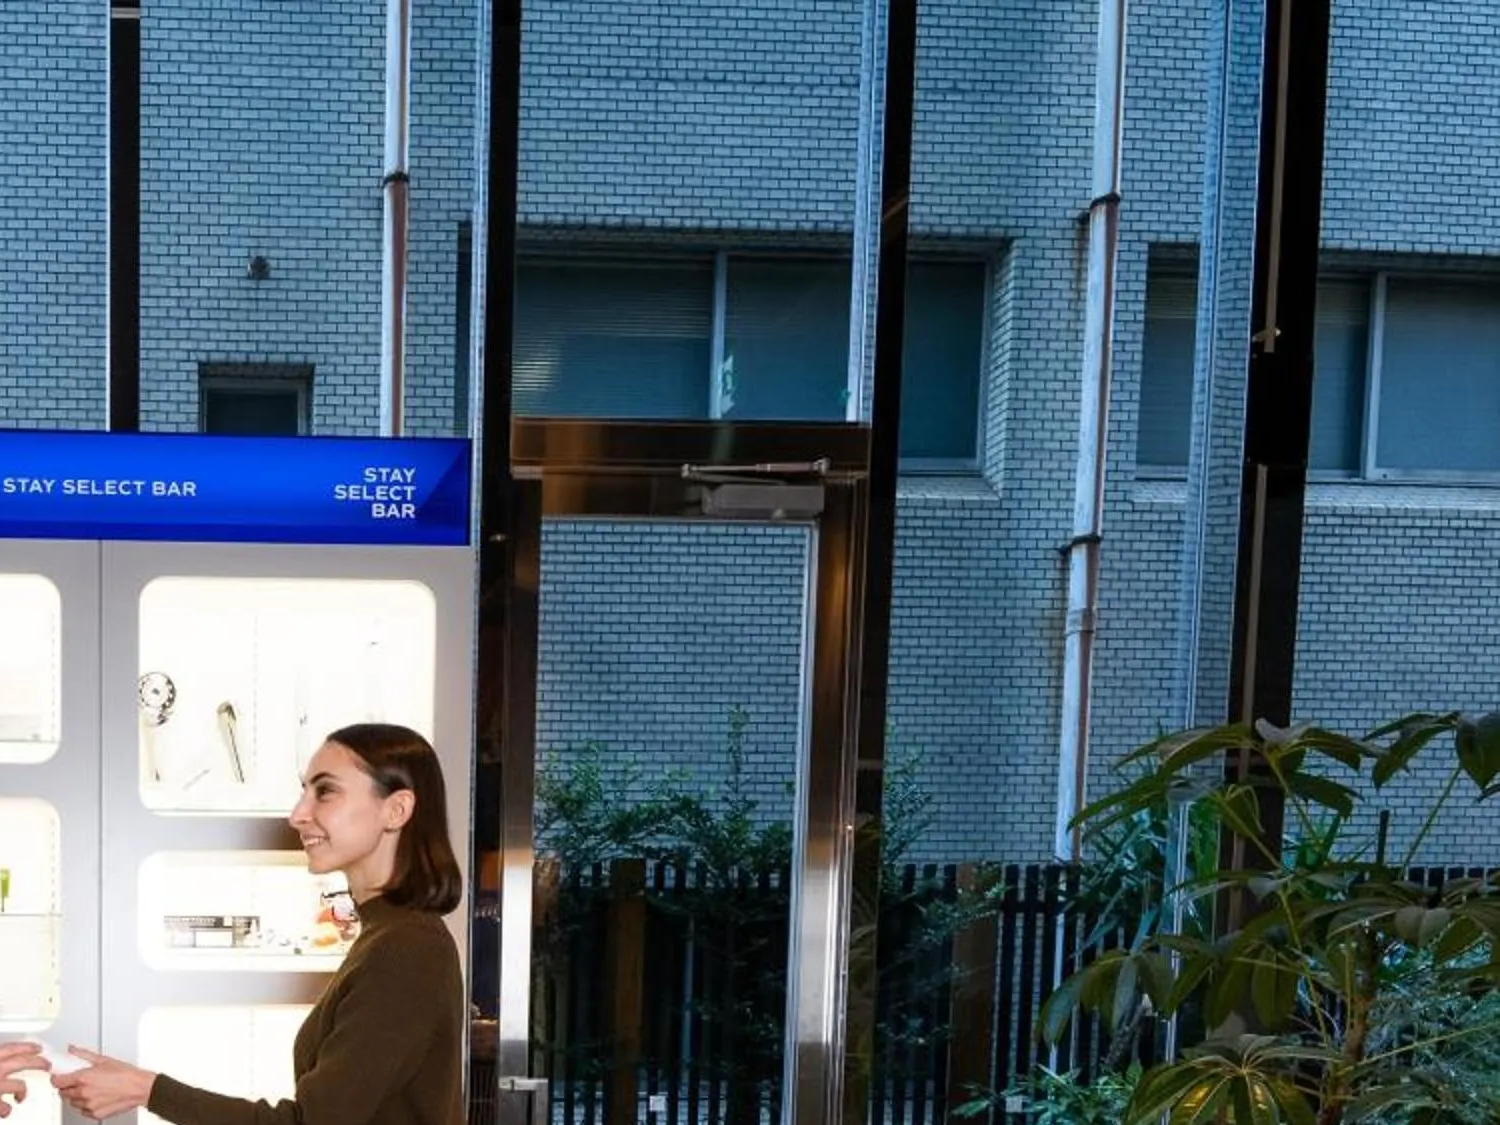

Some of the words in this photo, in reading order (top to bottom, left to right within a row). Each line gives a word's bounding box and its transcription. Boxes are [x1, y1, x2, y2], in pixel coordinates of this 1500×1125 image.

[363, 467, 417, 483] STAY
[3, 477, 56, 493] STAY
[62, 479, 146, 496] SELECT
[152, 481, 197, 497] BAR
[334, 484, 417, 501] SELECT
[371, 503, 416, 519] BAR
